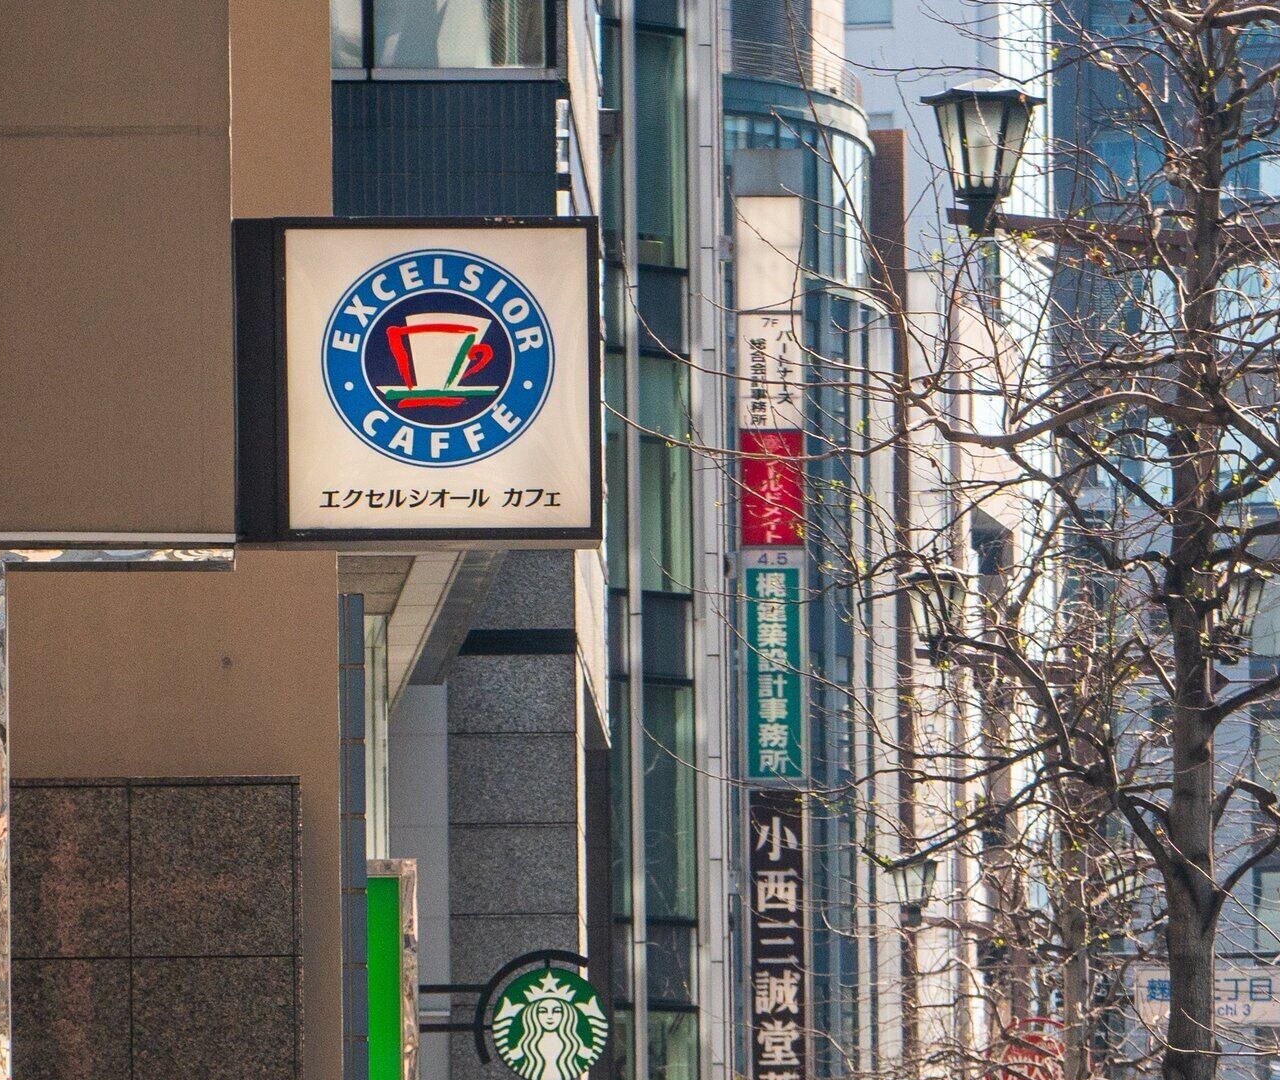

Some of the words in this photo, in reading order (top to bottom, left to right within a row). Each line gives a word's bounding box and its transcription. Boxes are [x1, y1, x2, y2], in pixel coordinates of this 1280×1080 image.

[331, 258, 544, 353] EXCELSIOR
[320, 488, 489, 508] エクセルシオール
[502, 487, 561, 507] カフェ
